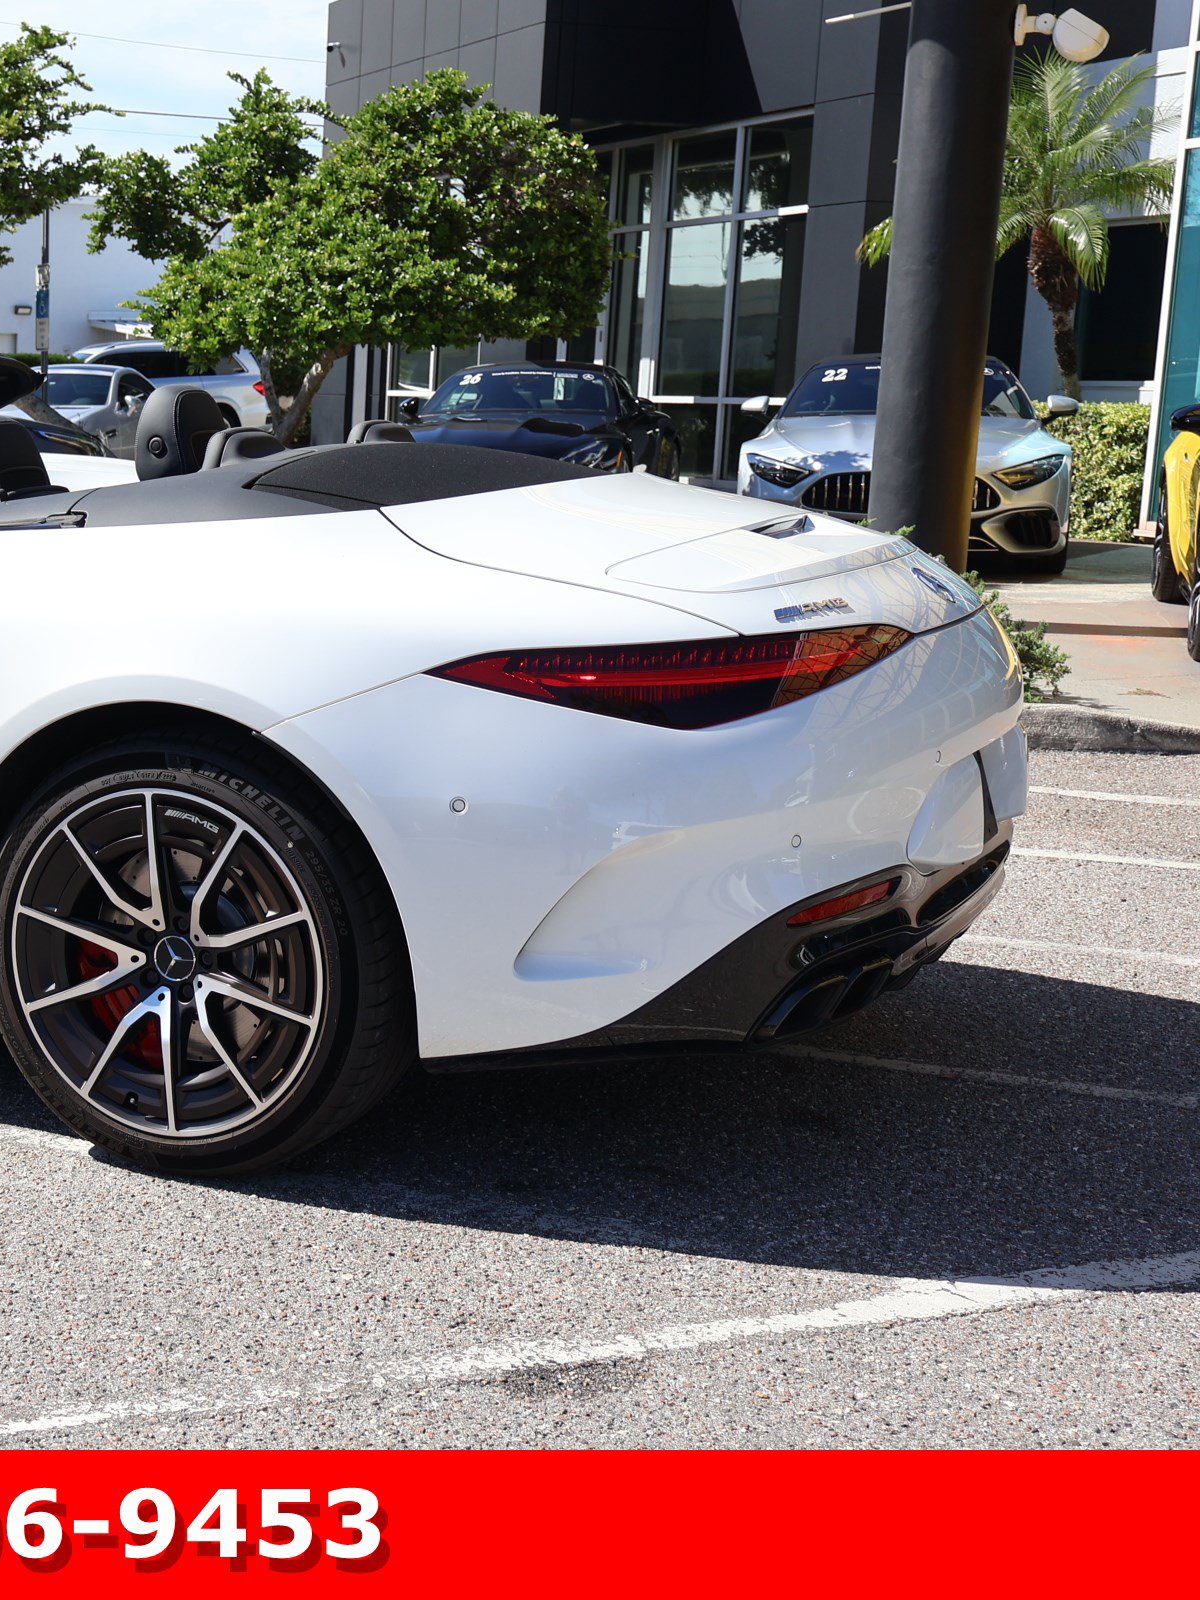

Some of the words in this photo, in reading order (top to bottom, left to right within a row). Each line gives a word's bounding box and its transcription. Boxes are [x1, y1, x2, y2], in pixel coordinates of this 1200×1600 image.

[459, 373, 483, 385] 26
[822, 368, 848, 382] 22
[197, 763, 305, 841] MICHELIN
[182, 813, 220, 834] AMG
